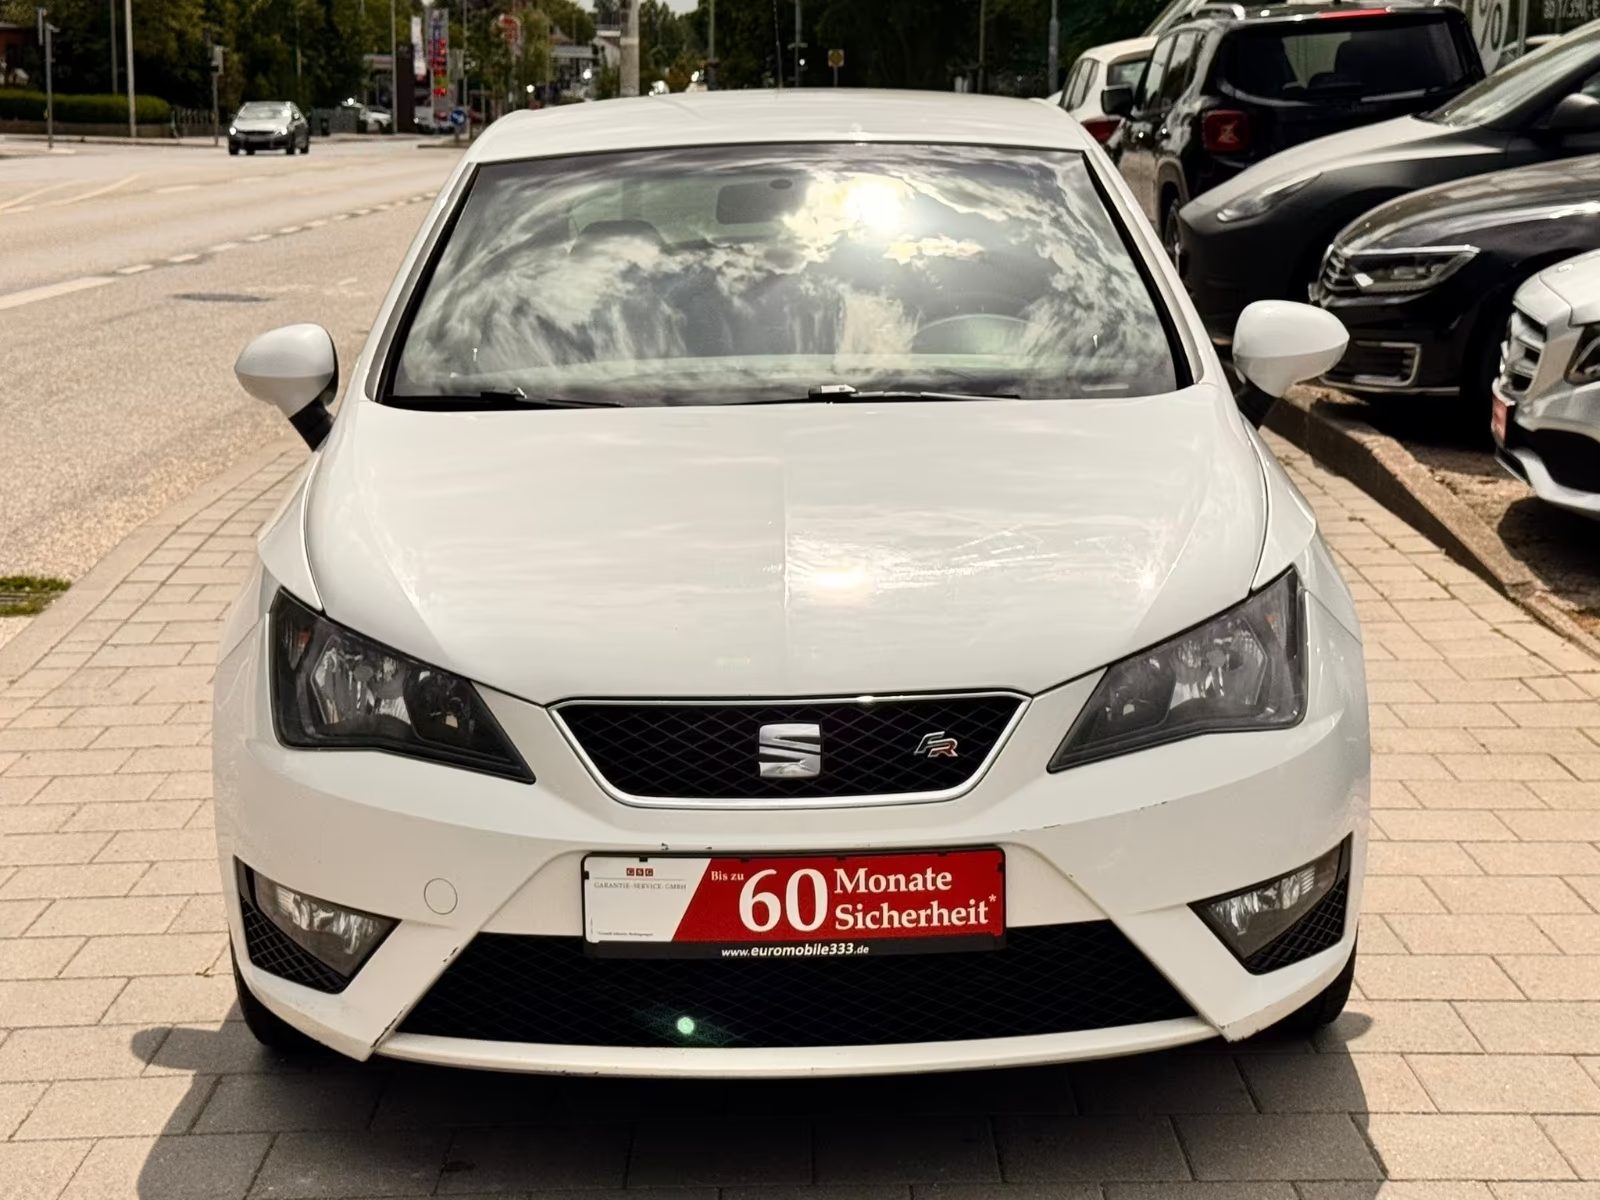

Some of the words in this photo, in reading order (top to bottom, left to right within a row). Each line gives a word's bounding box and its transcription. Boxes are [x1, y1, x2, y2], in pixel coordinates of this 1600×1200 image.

[914, 730, 959, 758] FR
[711, 870, 728, 881] Bis
[729, 872, 745, 881] zu
[834, 867, 953, 894] Monate
[738, 868, 828, 933] 60
[721, 942, 870, 958] www.euromobile333.de
